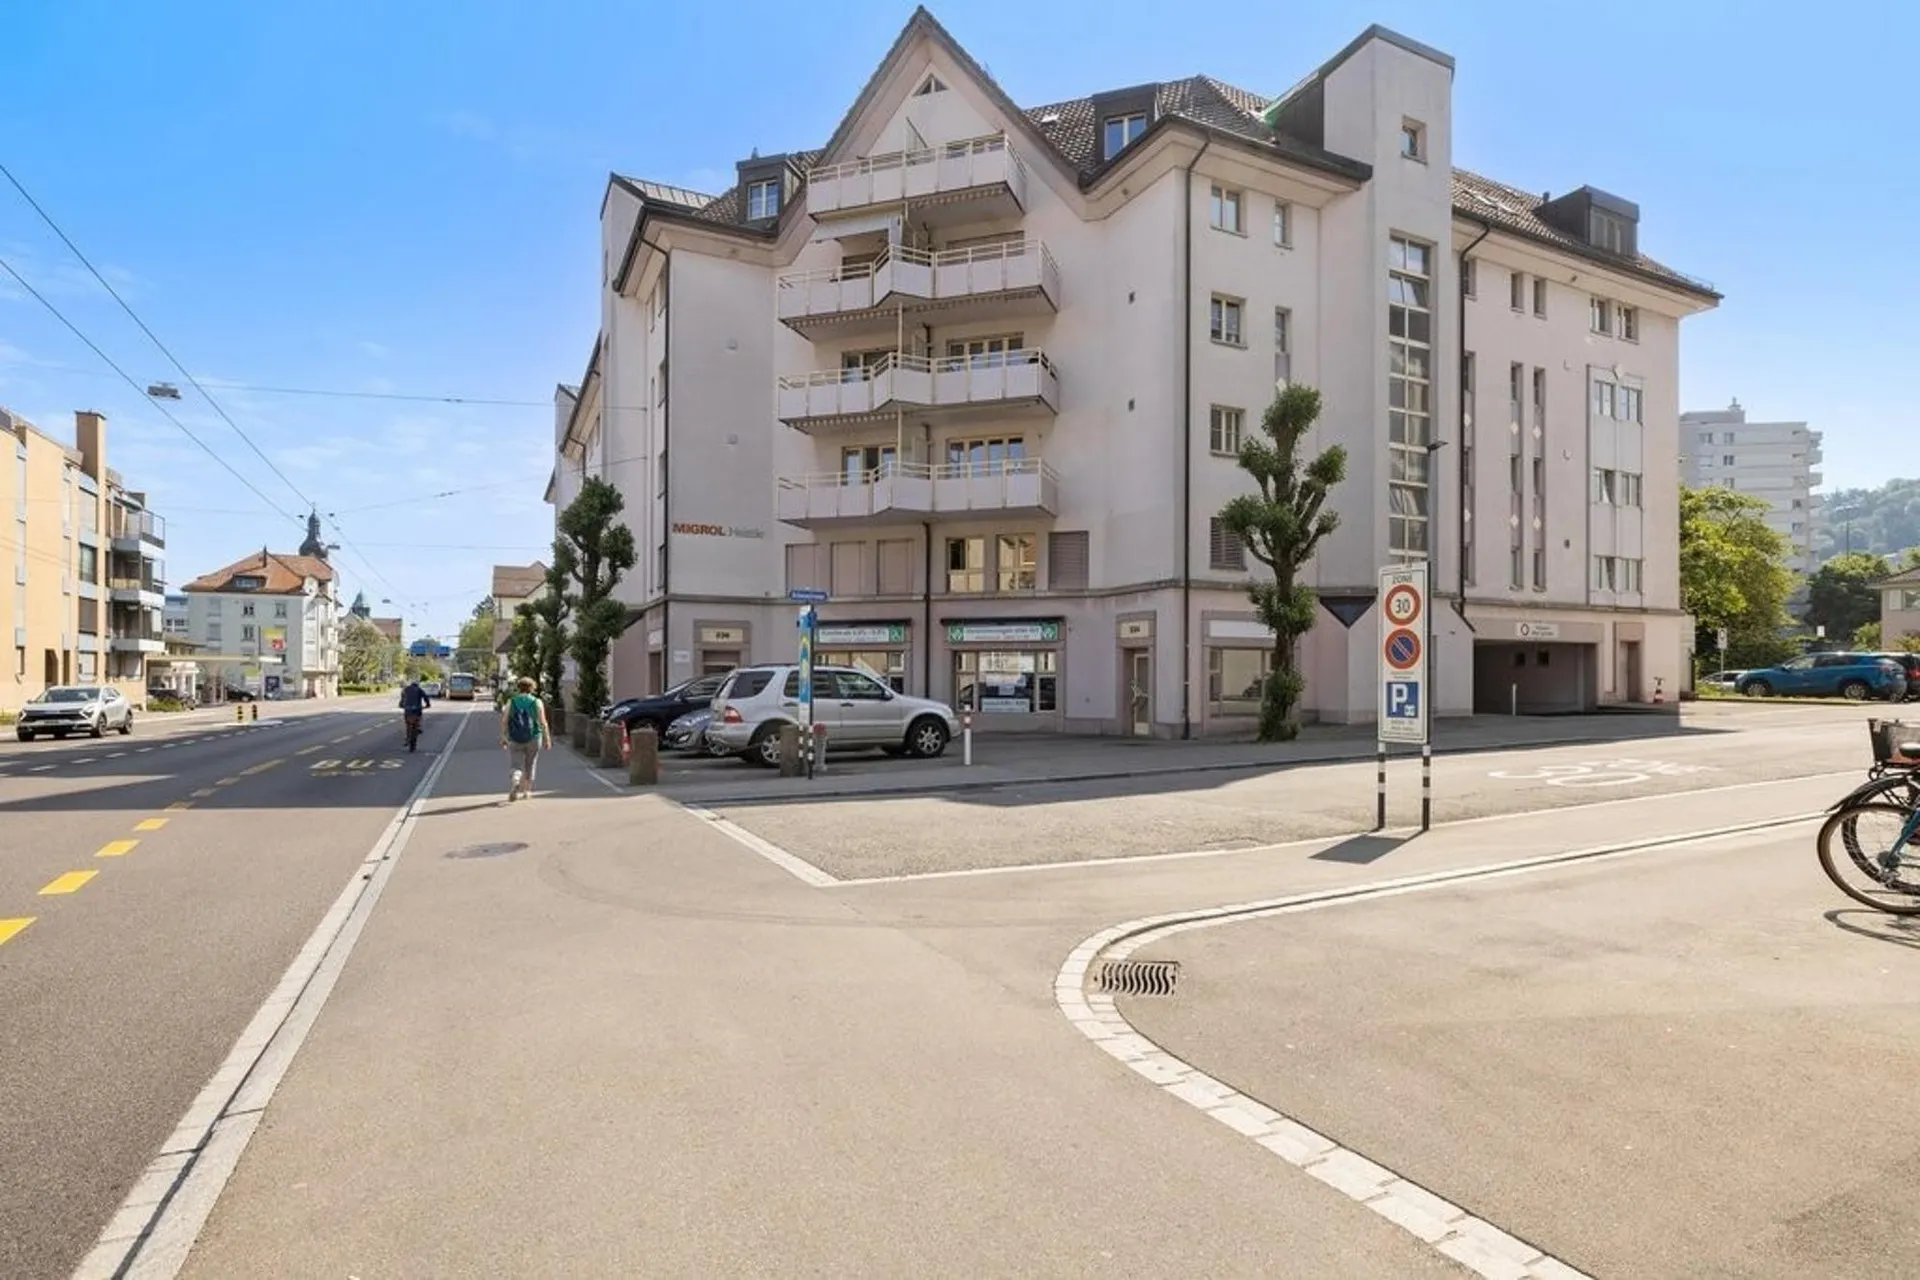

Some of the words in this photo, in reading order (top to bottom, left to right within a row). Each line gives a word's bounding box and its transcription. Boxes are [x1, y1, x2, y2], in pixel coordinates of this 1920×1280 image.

[672, 523, 727, 537] MIGROL
[1395, 598, 1411, 614] 30
[1392, 684, 1408, 713] P
